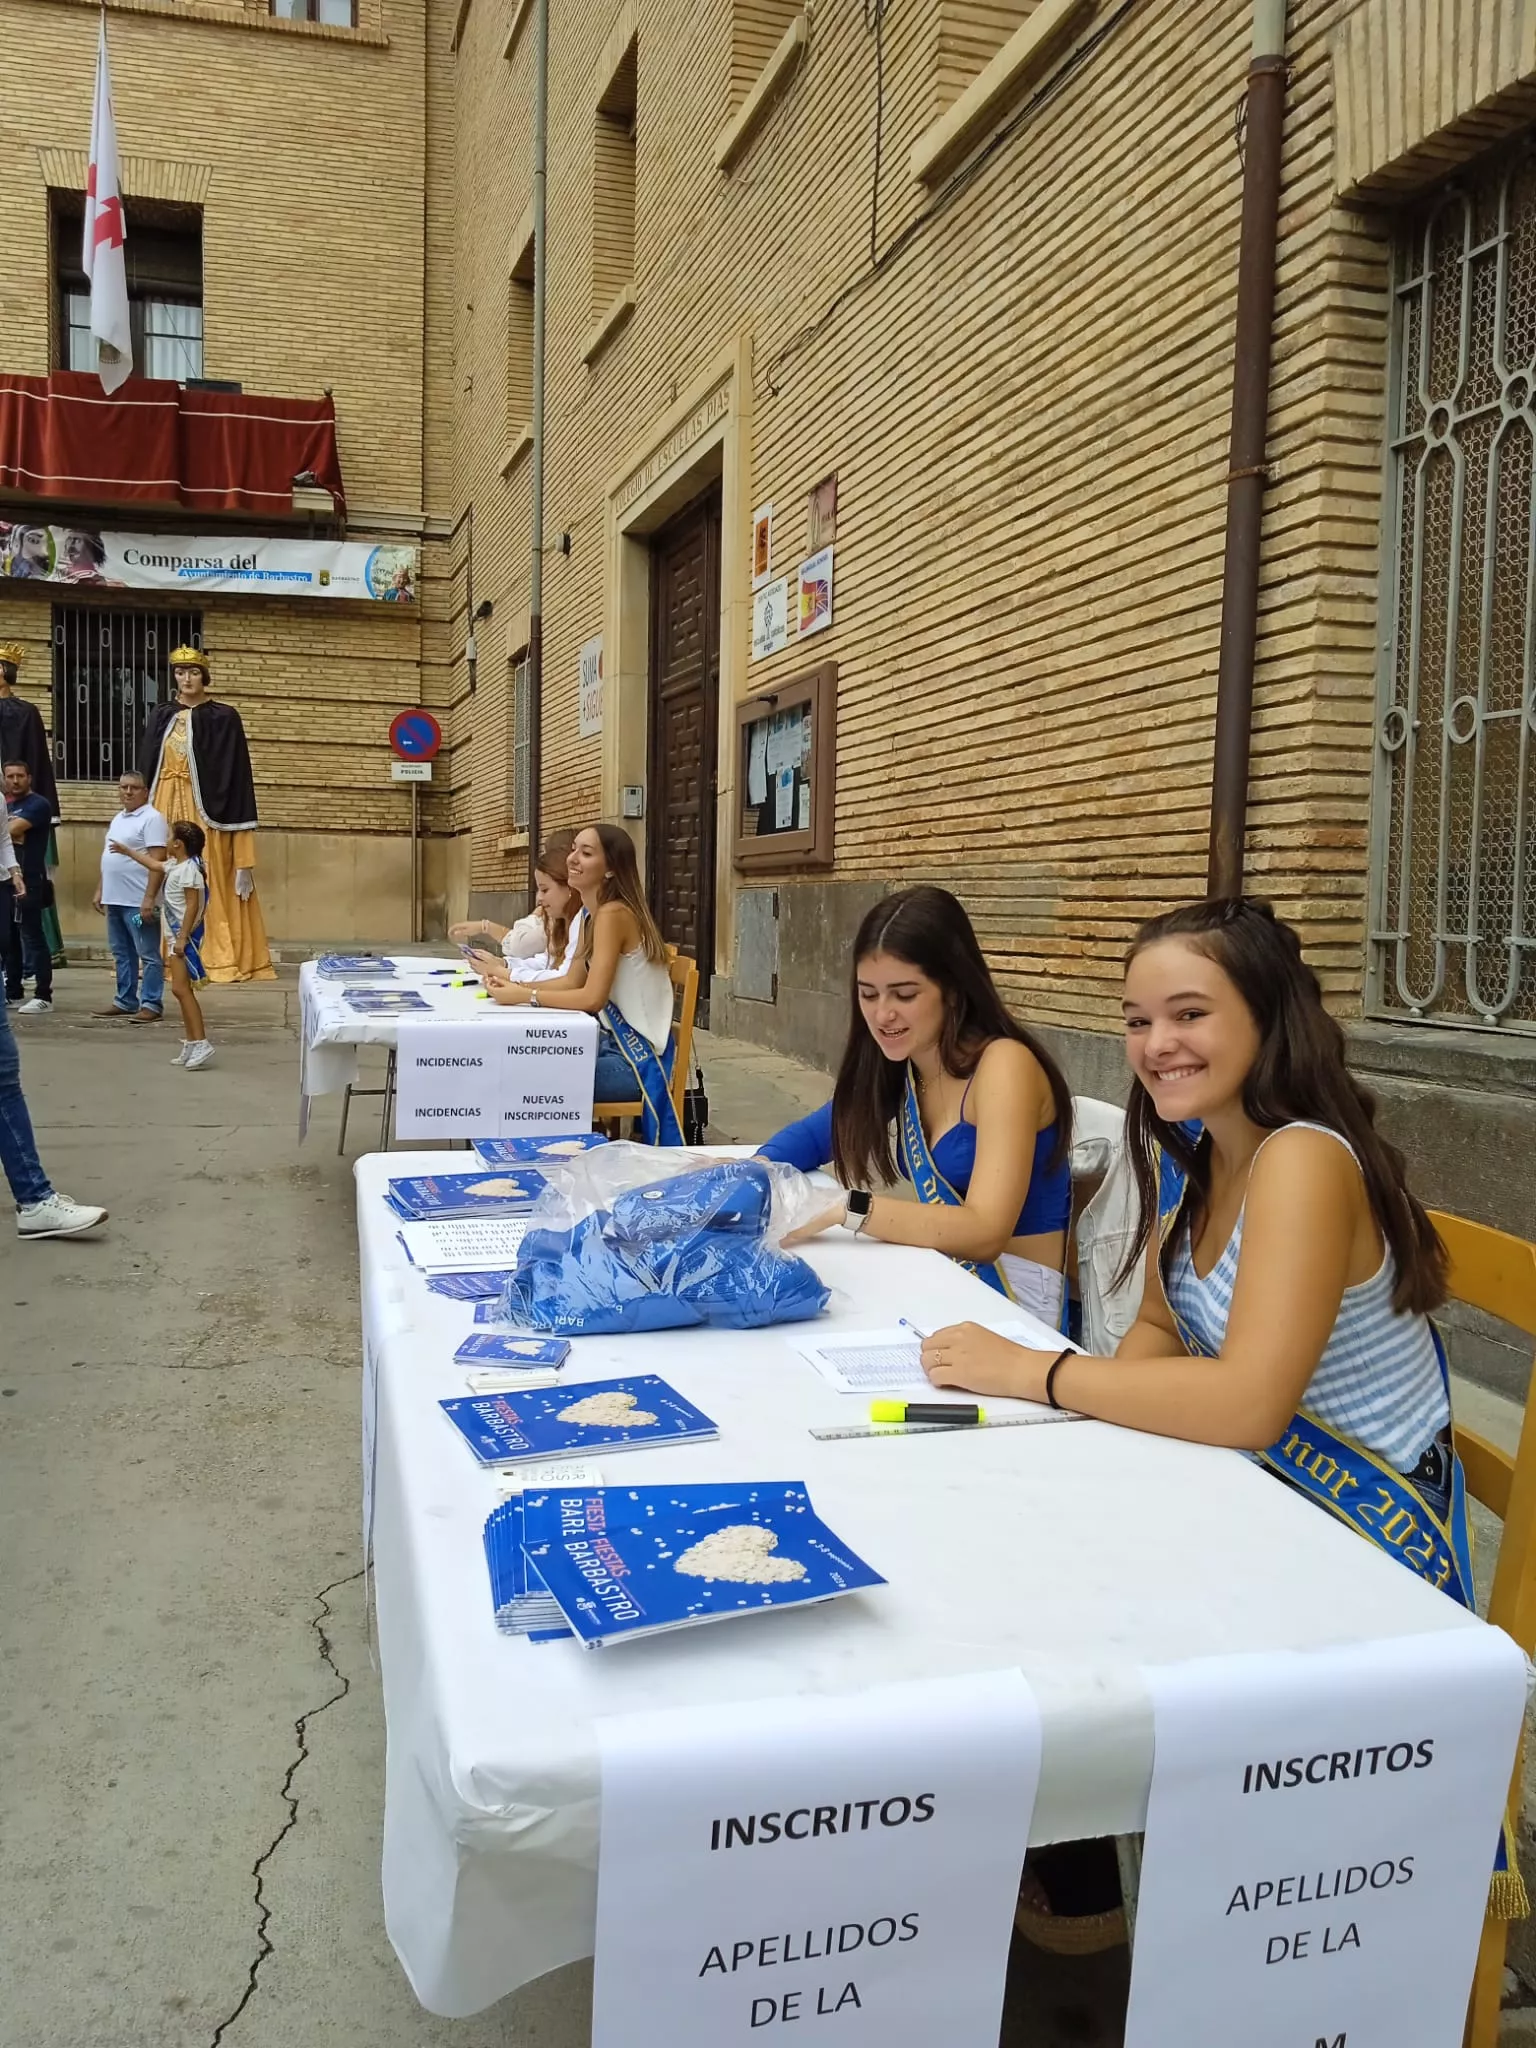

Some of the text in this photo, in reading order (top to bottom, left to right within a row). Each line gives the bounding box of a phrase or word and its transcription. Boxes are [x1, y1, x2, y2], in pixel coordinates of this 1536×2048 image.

[645, 460, 654, 486] DE
[659, 413, 703, 472] ESCUELAS
[707, 387, 730, 425] PIAS
[123, 548, 257, 572] Comparsa del
[182, 569, 309, 582] Ayuntamiento de Barbastro
[507, 1045, 584, 1056] INSCRIPCIONES
[525, 1029, 568, 1039] NUEVAS
[416, 1057, 483, 1067] INCIDENCIAS
[415, 1107, 481, 1118] INCIDENCIAS
[504, 1111, 581, 1121] INSCRIPCIONES
[522, 1095, 564, 1104] NUEVAS
[471, 1401, 530, 1450] BARBASTRO
[491, 1399, 521, 1425] FIESTAS
[588, 1537, 632, 1579] FIESTAS
[564, 1540, 640, 1621] BARBASTRO
[1242, 1738, 1435, 1794] INSCRITOS
[710, 1792, 936, 1851] INSCRITOS
[1225, 1856, 1415, 1916] APELLIDOS
[698, 1912, 920, 1978] APELLIDOS
[1265, 1921, 1362, 1965] DE LA
[750, 1981, 863, 2028] DE LA
